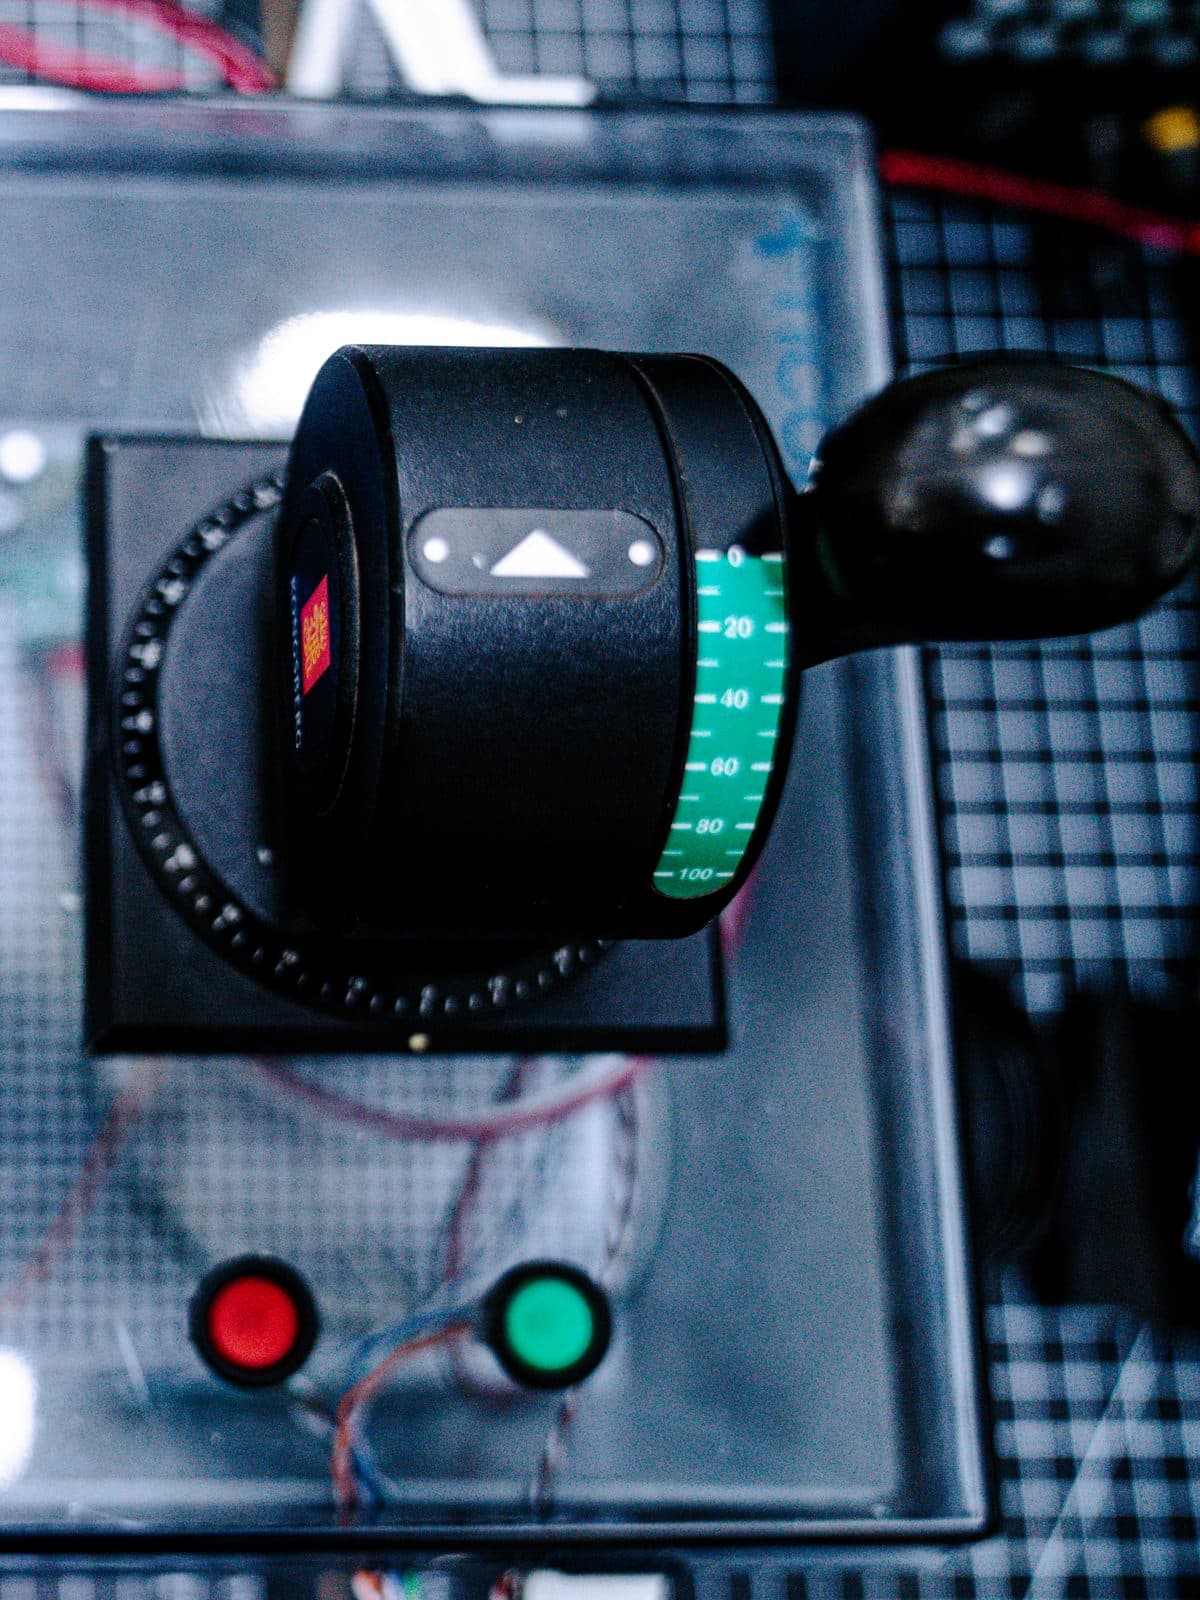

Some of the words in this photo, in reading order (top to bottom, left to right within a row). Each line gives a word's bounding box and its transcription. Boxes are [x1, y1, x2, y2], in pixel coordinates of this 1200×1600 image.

[727, 545, 744, 568] 0
[724, 616, 753, 639] 20
[720, 688, 749, 709] 40
[711, 757, 738, 776] 60
[695, 819, 723, 834] 80
[679, 868, 713, 880] 100
